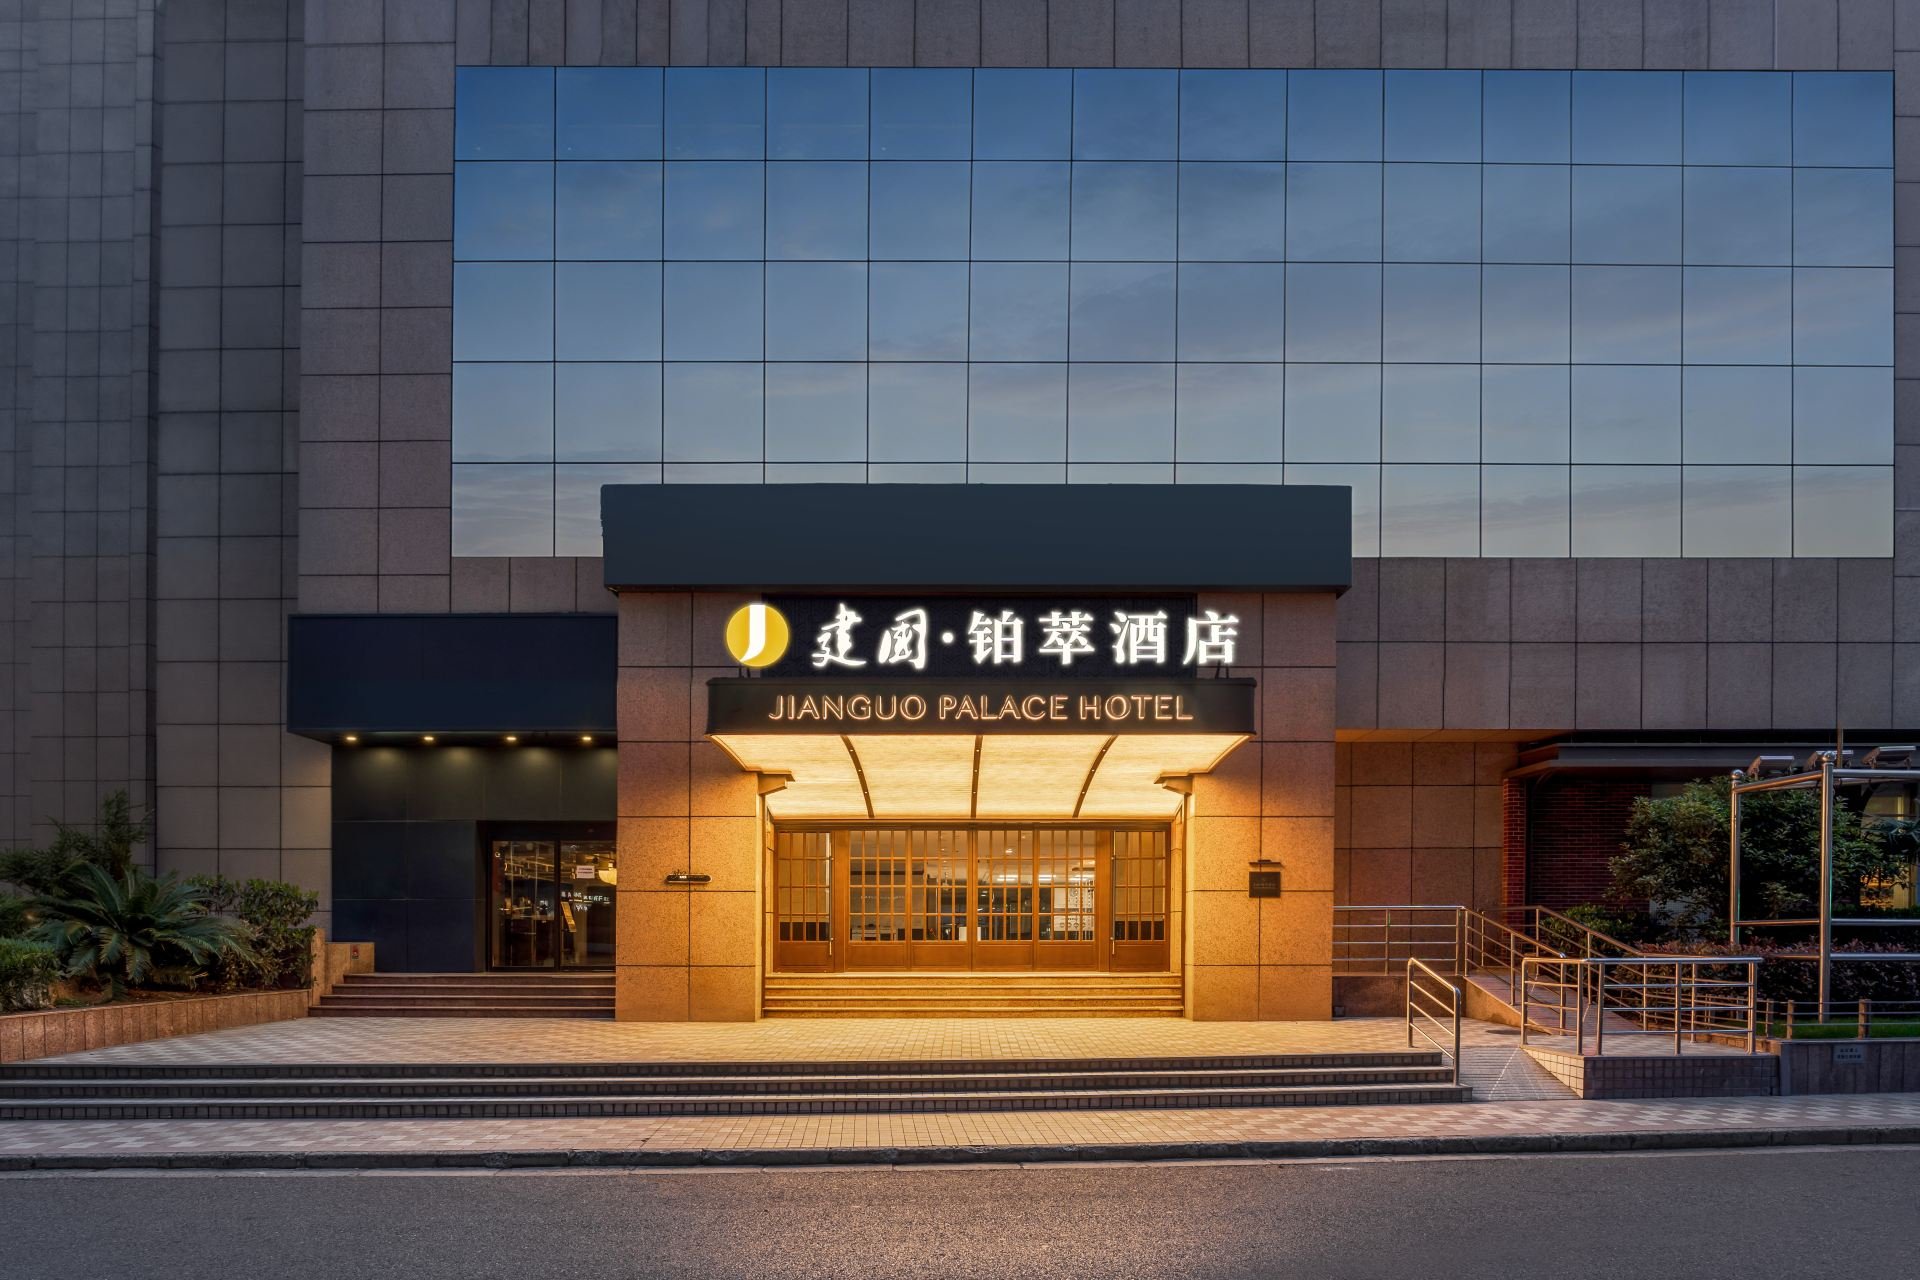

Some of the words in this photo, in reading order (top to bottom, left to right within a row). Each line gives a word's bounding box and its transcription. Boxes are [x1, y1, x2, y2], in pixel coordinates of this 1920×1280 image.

[768, 695, 927, 720] JIANGUO
[938, 695, 1068, 720] PALACE
[1080, 695, 1194, 720] HOTEL
